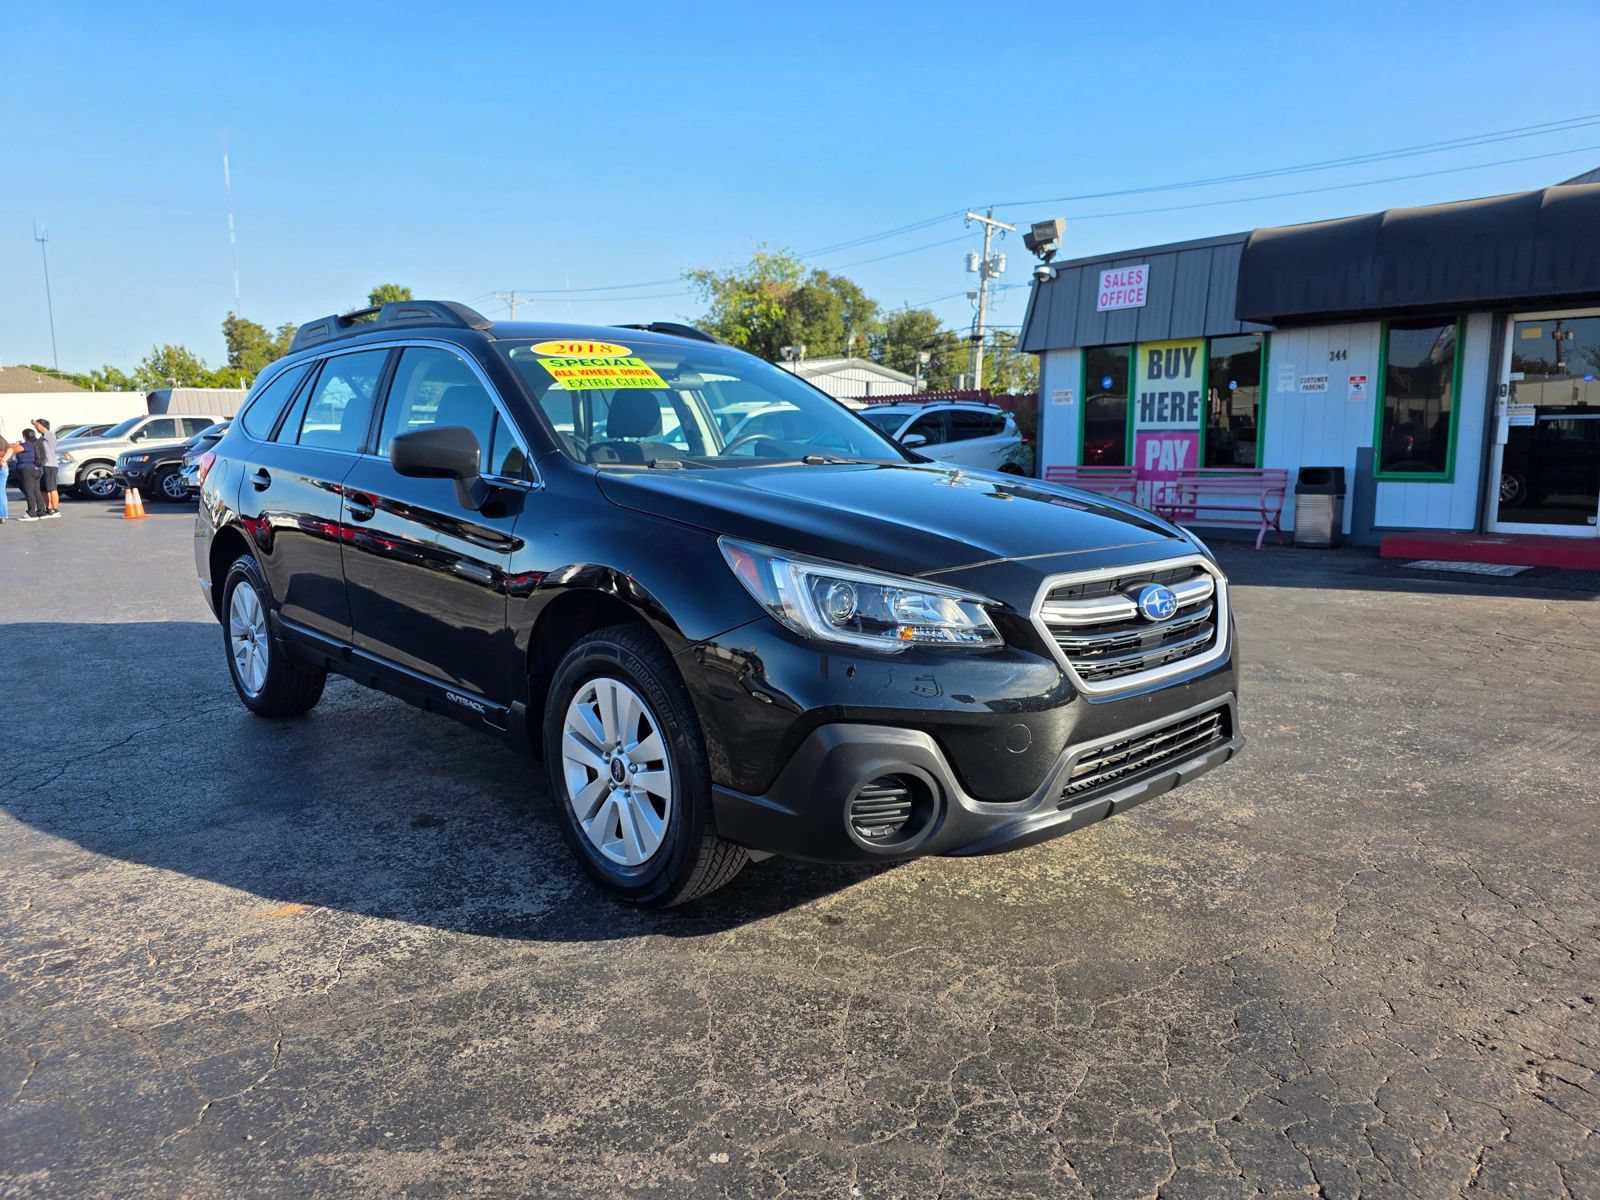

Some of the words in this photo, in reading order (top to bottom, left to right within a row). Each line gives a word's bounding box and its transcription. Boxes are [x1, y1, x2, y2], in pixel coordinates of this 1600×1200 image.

[1104, 270, 1143, 289] SALES
[1100, 287, 1144, 307] OFFICE
[554, 344, 613, 354] 2018
[1329, 349, 1348, 362] 344
[549, 358, 639, 368] SPECIAL
[1147, 346, 1198, 380] BUY
[554, 369, 576, 378] ALL
[578, 368, 617, 377] WHEEL
[621, 368, 653, 377] DRIVE
[1300, 376, 1328, 384] CUSTOMER
[568, 378, 616, 388] EXTRA
[617, 377, 660, 387] CLEAN
[1140, 391, 1200, 422] HERE
[1144, 439, 1190, 471] PAY
[446, 691, 485, 714] OUTBACK
